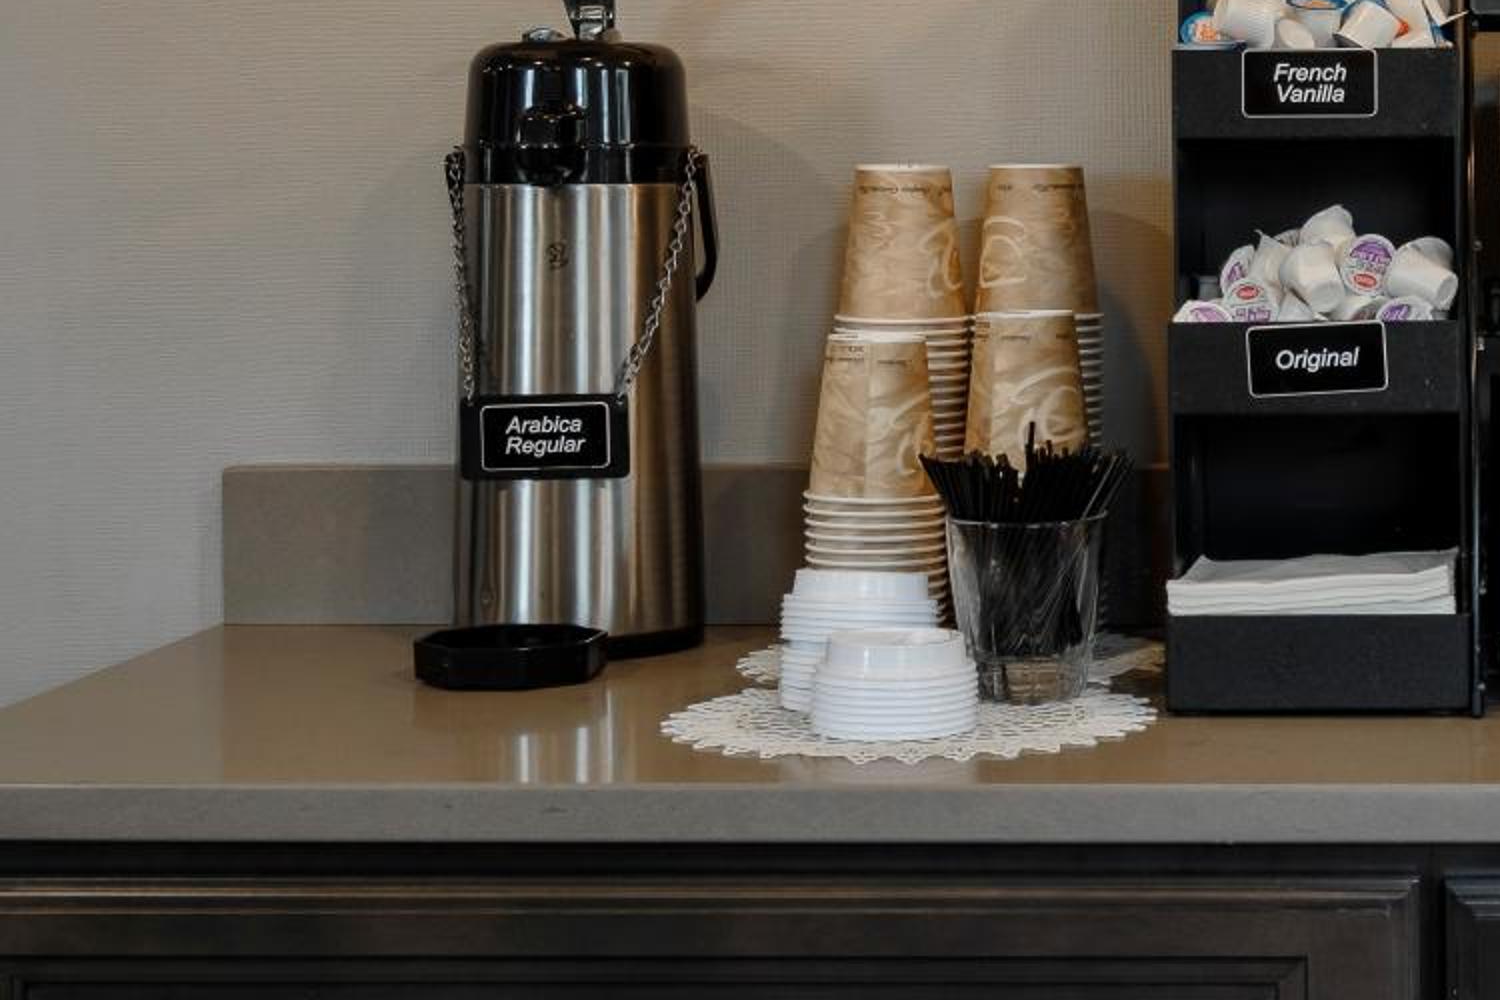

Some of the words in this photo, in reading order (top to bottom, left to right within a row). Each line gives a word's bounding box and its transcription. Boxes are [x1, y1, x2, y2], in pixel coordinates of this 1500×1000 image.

[1273, 62, 1347, 82] French
[1276, 84, 1345, 103] Vanilla
[1275, 346, 1360, 373] Original
[505, 415, 582, 434] Arabica
[505, 435, 586, 458] Regular
